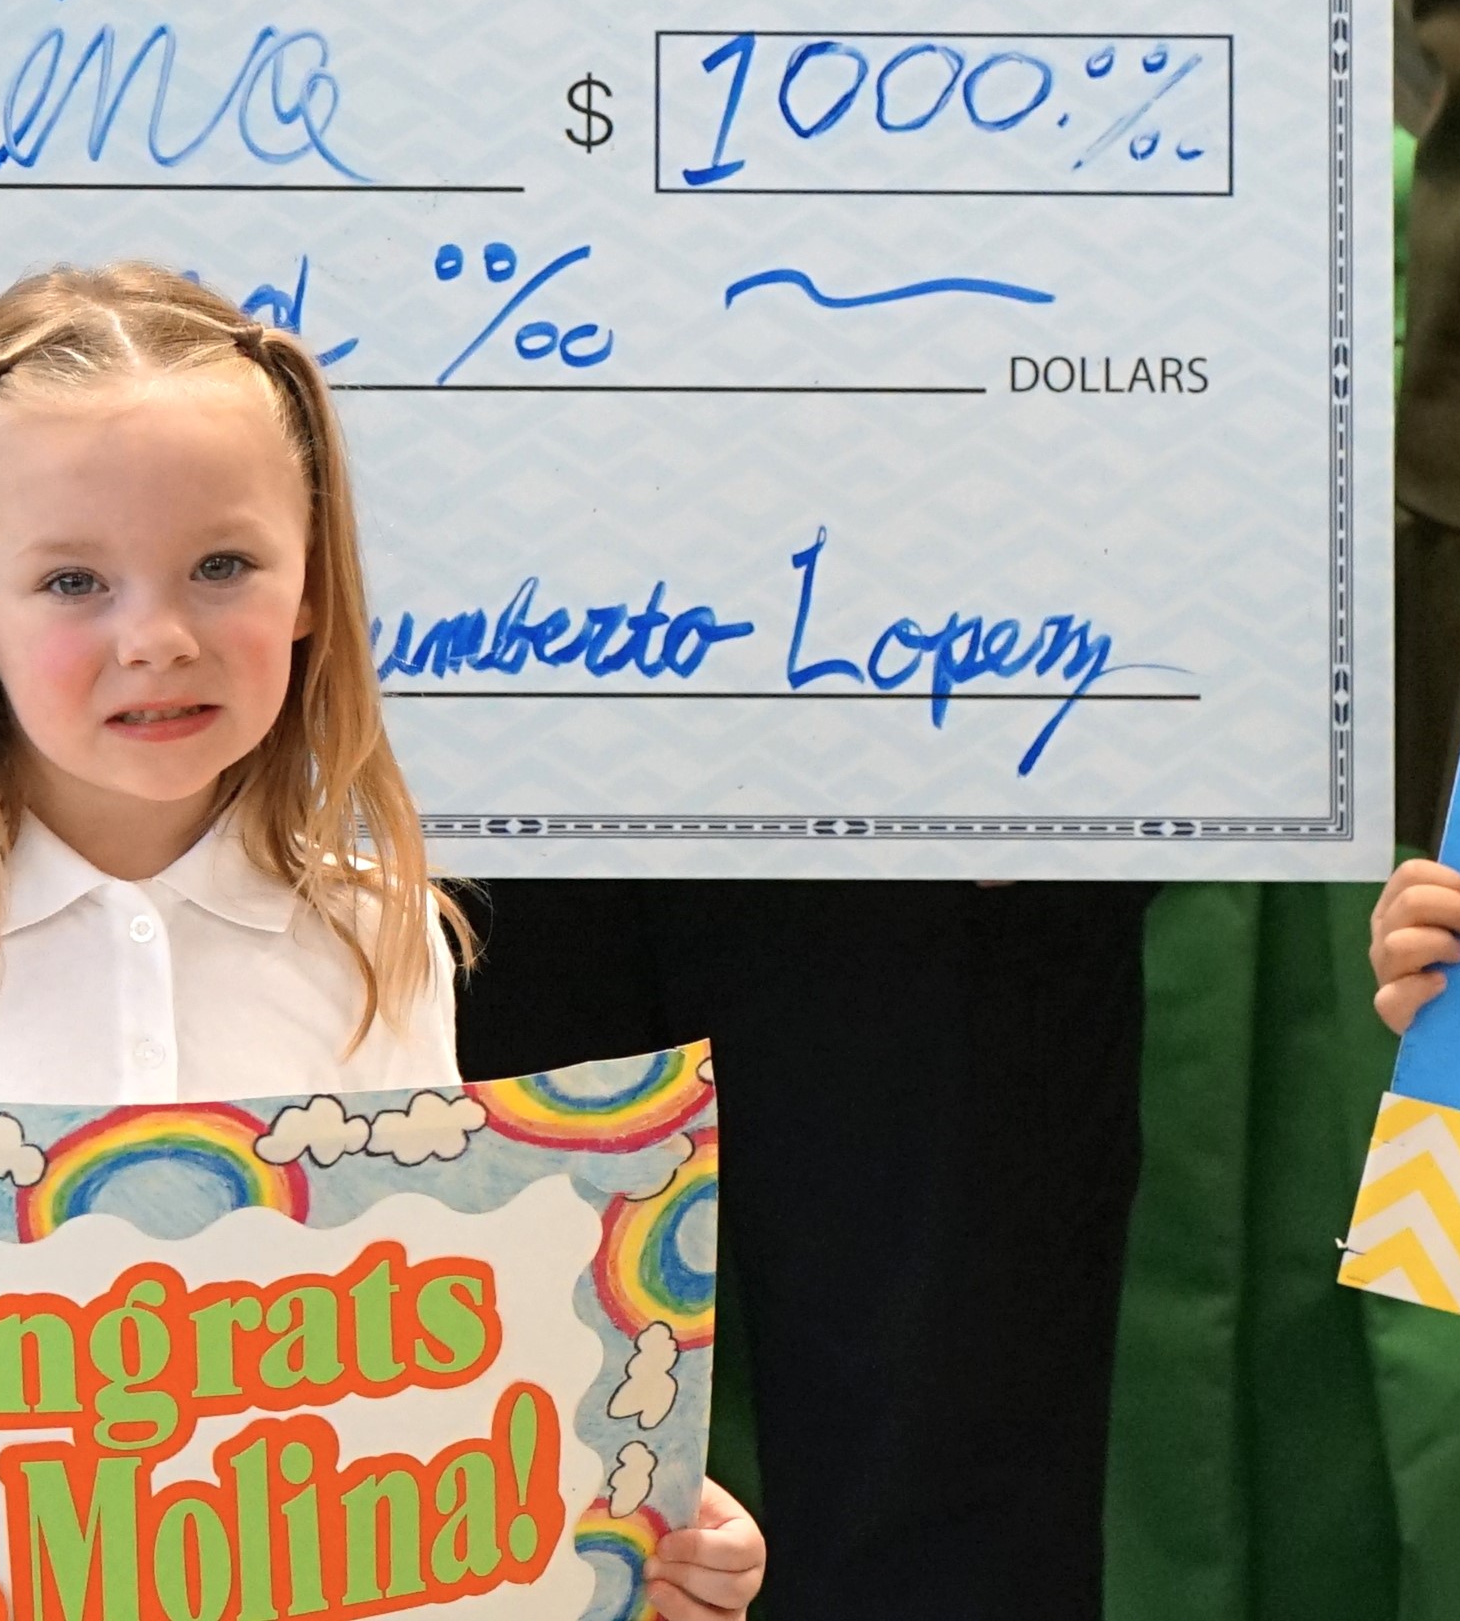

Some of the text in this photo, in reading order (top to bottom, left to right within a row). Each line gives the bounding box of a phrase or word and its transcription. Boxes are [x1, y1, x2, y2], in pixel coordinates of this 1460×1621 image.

[563, 71, 615, 155] $
[1008, 355, 1210, 395] DOLLARS
[20, 1388, 542, 1621] Molina!
